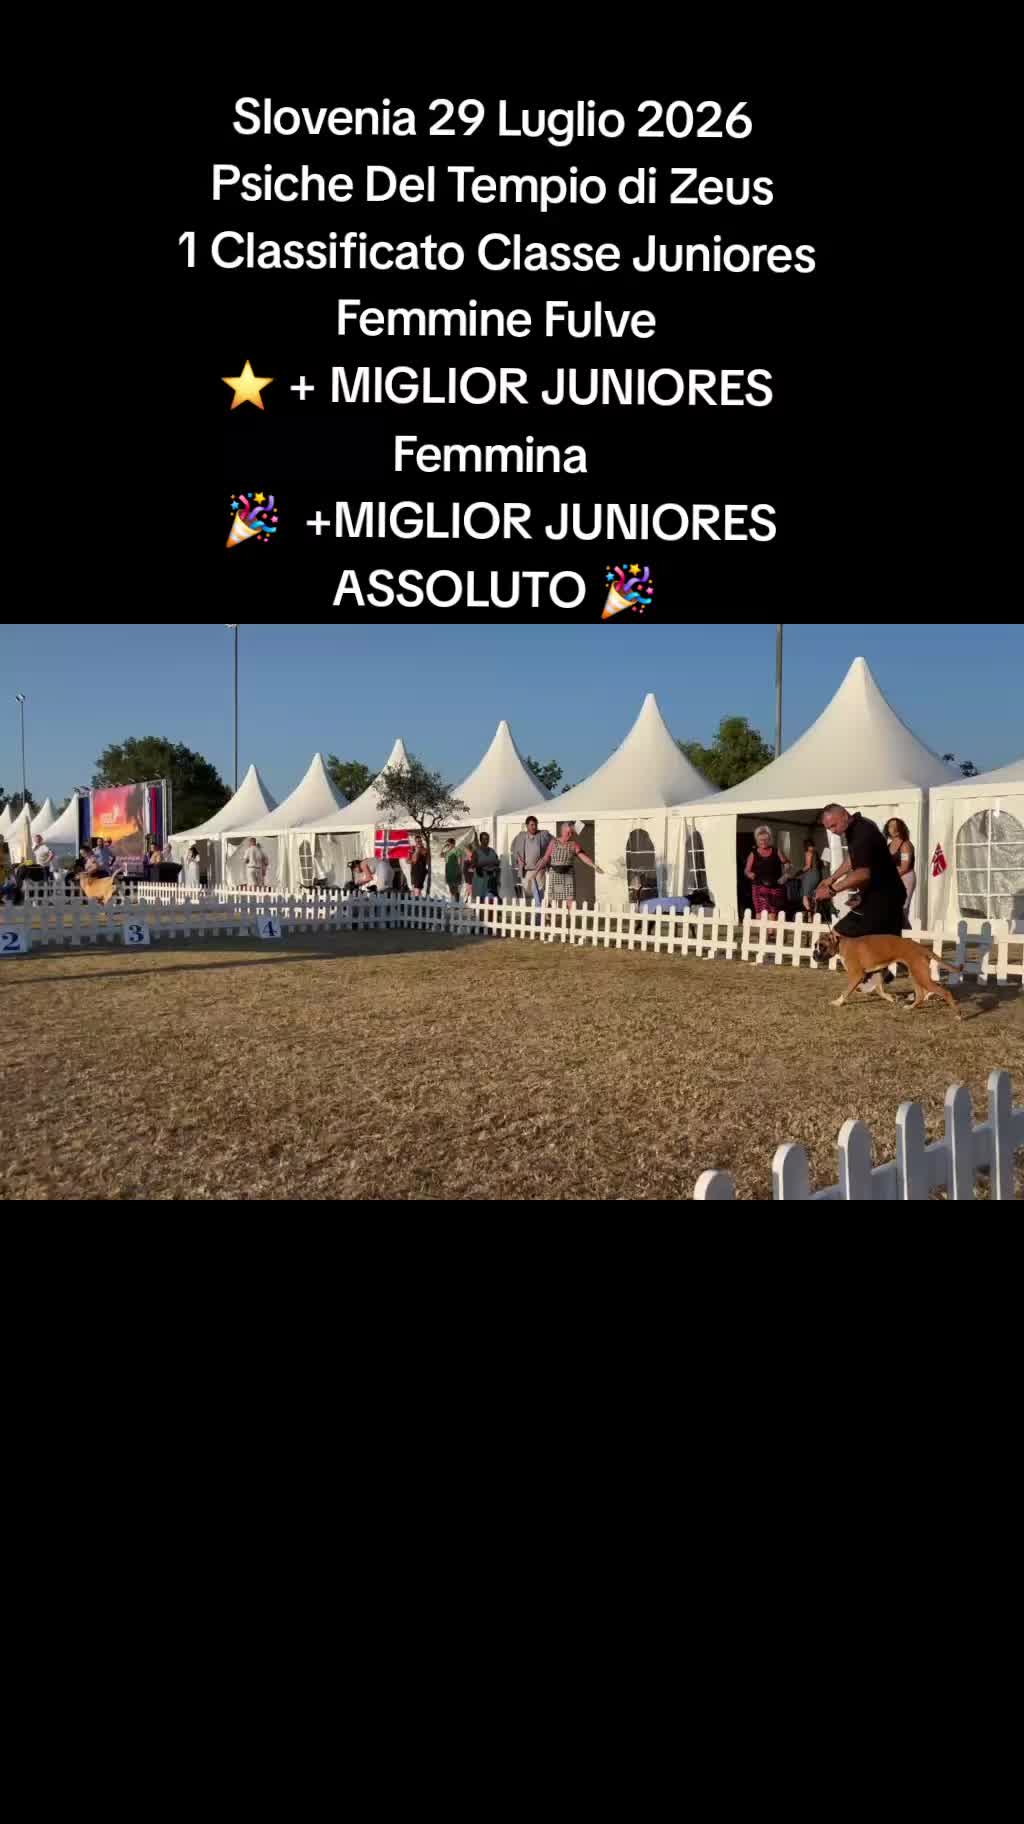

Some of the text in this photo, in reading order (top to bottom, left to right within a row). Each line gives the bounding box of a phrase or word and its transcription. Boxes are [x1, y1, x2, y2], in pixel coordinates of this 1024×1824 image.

[128, 924, 145, 943] 3
[262, 920, 277, 937] 4
[2, 931, 21, 950] 2
